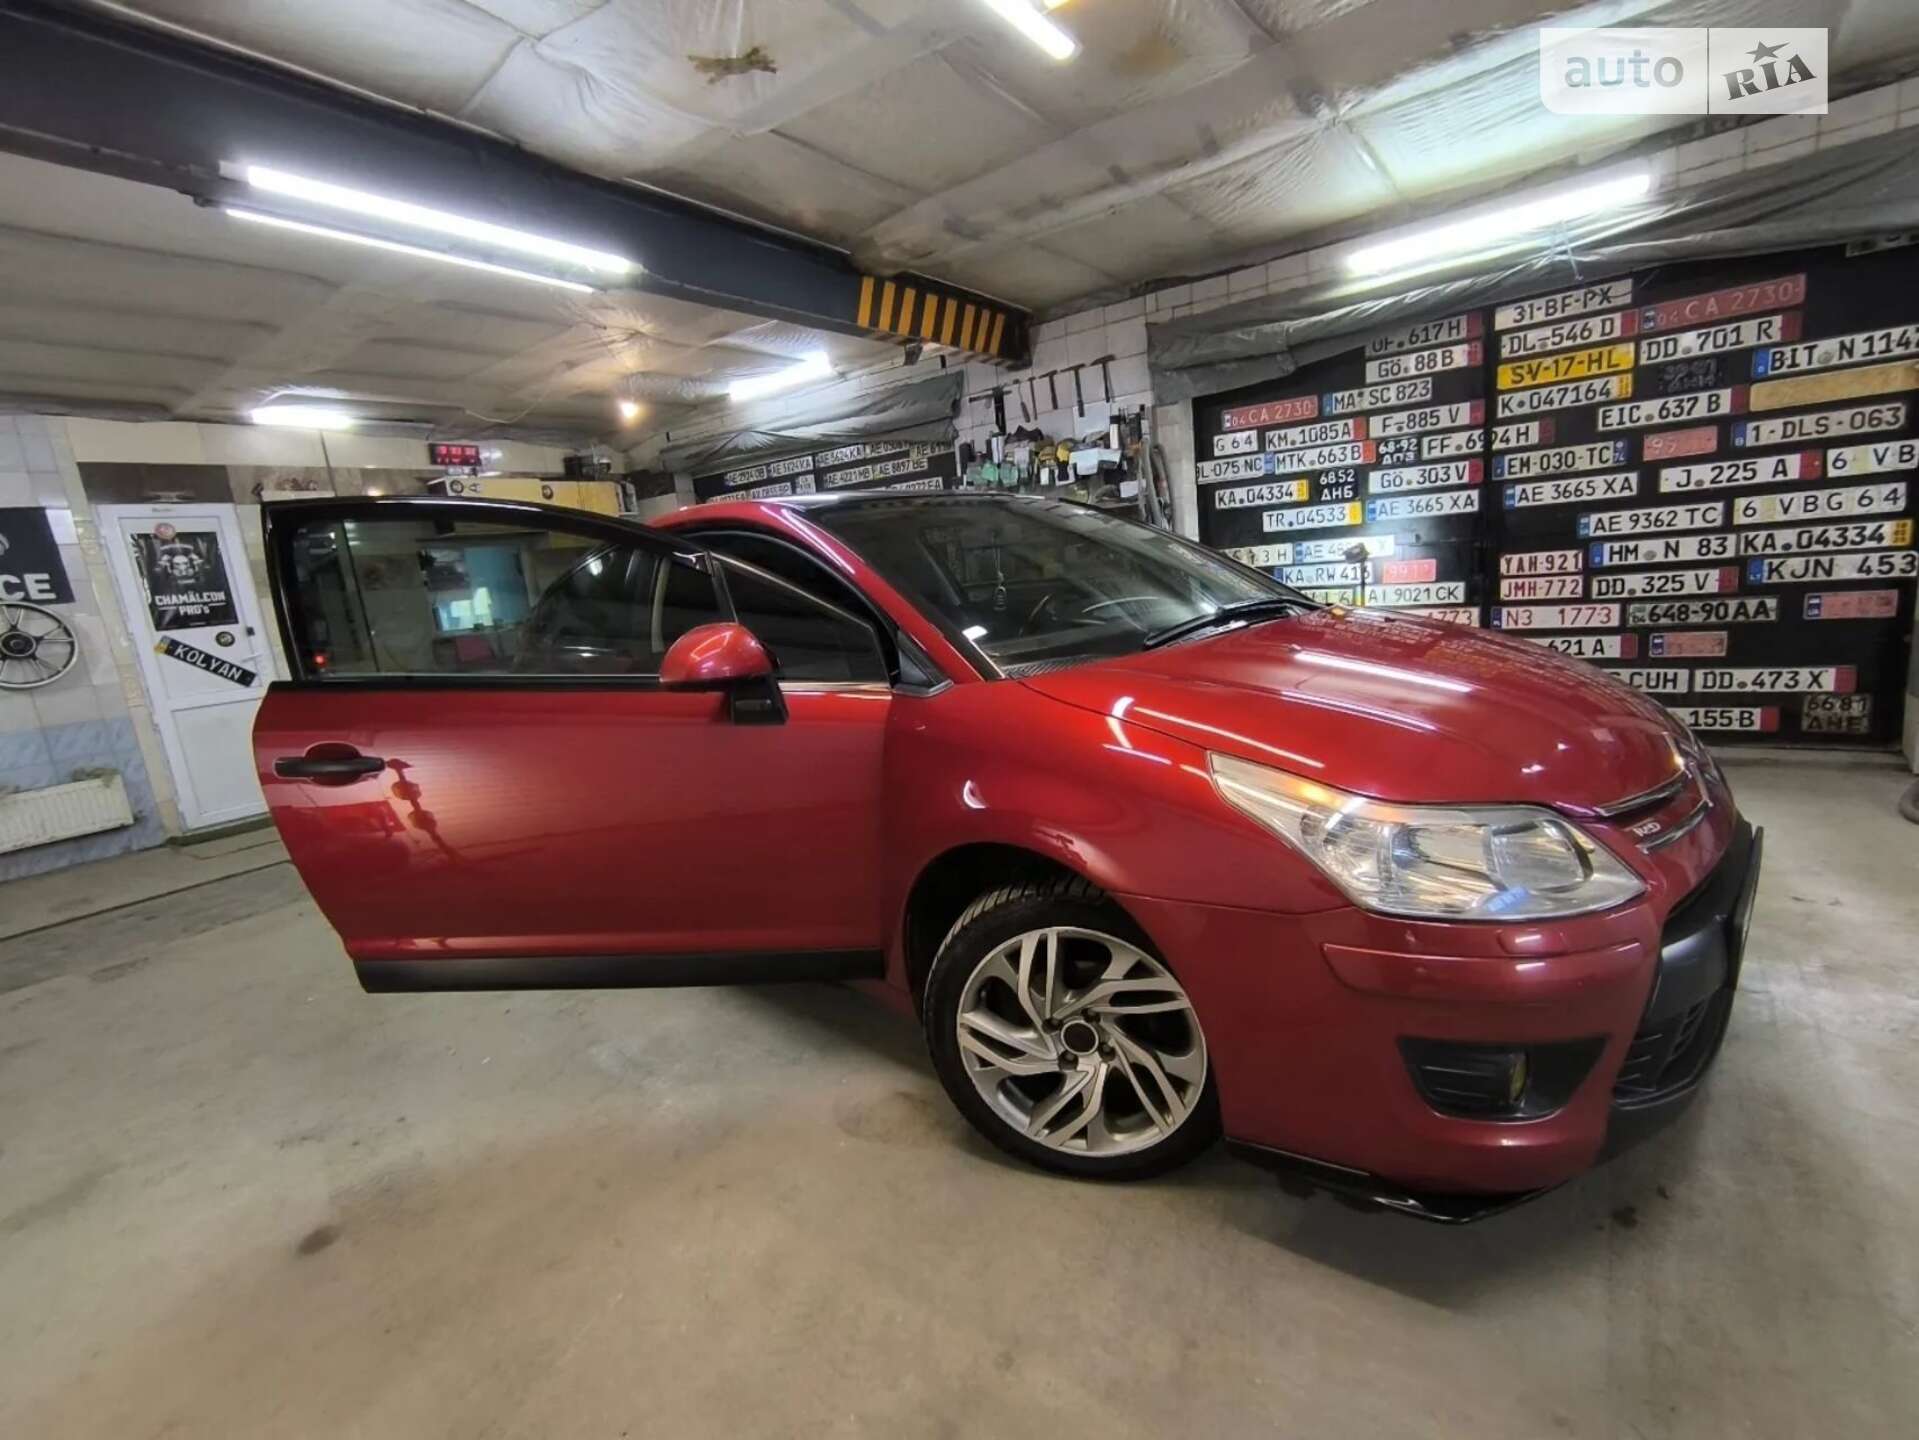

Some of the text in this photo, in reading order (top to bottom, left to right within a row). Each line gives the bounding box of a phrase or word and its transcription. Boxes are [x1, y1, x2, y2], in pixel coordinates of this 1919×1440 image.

[1513, 286, 1613, 323] 31-BF-PX
[1685, 298, 1719, 318] CA
[1731, 281, 1794, 311] 2730
[1409, 323, 1443, 347] 617
[1697, 325, 1744, 350] 701
[1757, 319, 1774, 341] R
[1838, 339, 1855, 361] N
[1369, 387, 1392, 405] SC
[1396, 380, 1430, 401] 823
[1249, 407, 1269, 423] CA
[1274, 400, 1312, 420] 2730
[1276, 450, 1307, 469] MTK
[1710, 461, 1758, 485] 225
[1771, 458, 1789, 478] A
[1319, 469, 1355, 485] 6852
[1216, 483, 1294, 507] KA 04334
[1517, 475, 1634, 504] AE 3665 XA
[1378, 491, 1475, 516] AE 3665 XA
[1742, 500, 1758, 517] 6
[1266, 505, 1346, 529] TR 04533
[1593, 505, 1719, 534] AE 9362 TC
[1609, 535, 1728, 563] HM N 83
[1743, 523, 1886, 553] KA 04334
[1316, 565, 1337, 583] RW
[1768, 558, 1835, 580] KJN
[1857, 553, 1916, 575] 453
[1394, 585, 1432, 603] 9021
[1435, 583, 1460, 601] CK
[1503, 578, 1580, 599] JMH-772
[1595, 573, 1710, 597] DD 325 V
[1557, 606, 1613, 626] 1773
[1592, 638, 1605, 656] A
[175, 643, 244, 682] KOLYAN
[1702, 669, 1825, 690] DD 473 X
